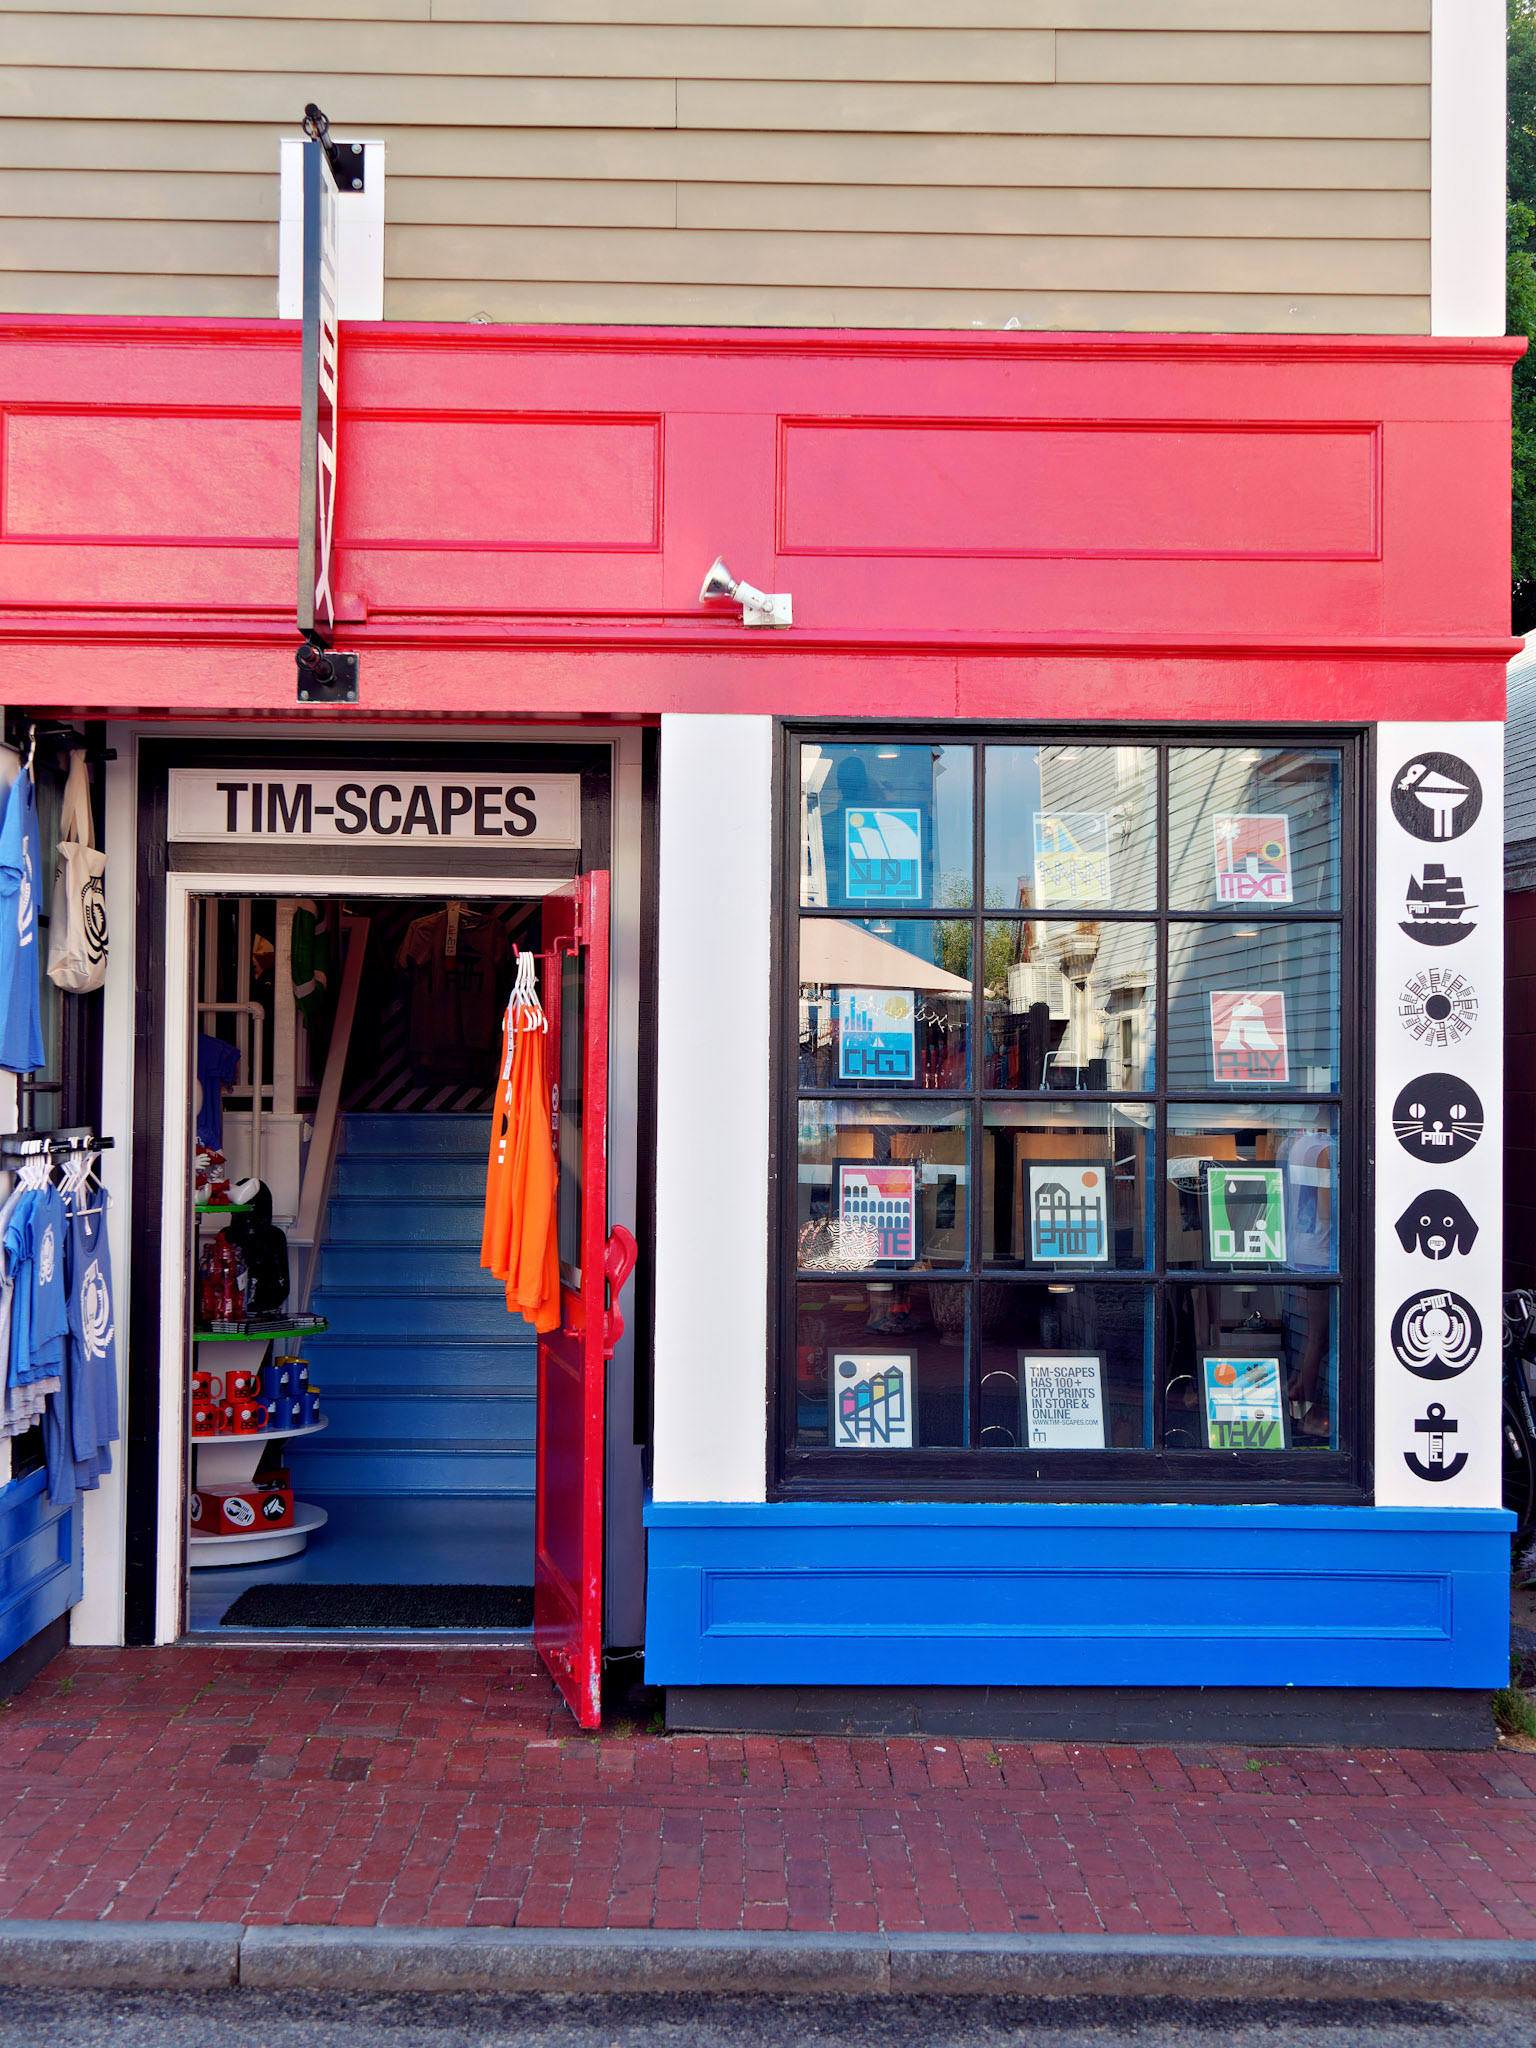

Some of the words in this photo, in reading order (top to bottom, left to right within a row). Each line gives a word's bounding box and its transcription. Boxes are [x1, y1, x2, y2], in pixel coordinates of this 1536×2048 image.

[216, 783, 538, 837] TIM-SCAPES
[1030, 1366, 1095, 1378] TIM-SCAPES
[1030, 1377, 1052, 1388] HAS
[1031, 1387, 1054, 1398] CITY
[1057, 1388, 1095, 1399] PRINTS
[1032, 1398, 1042, 1409] IN
[1045, 1398, 1079, 1409] STORE
[1032, 1409, 1071, 1419] ONLINE
